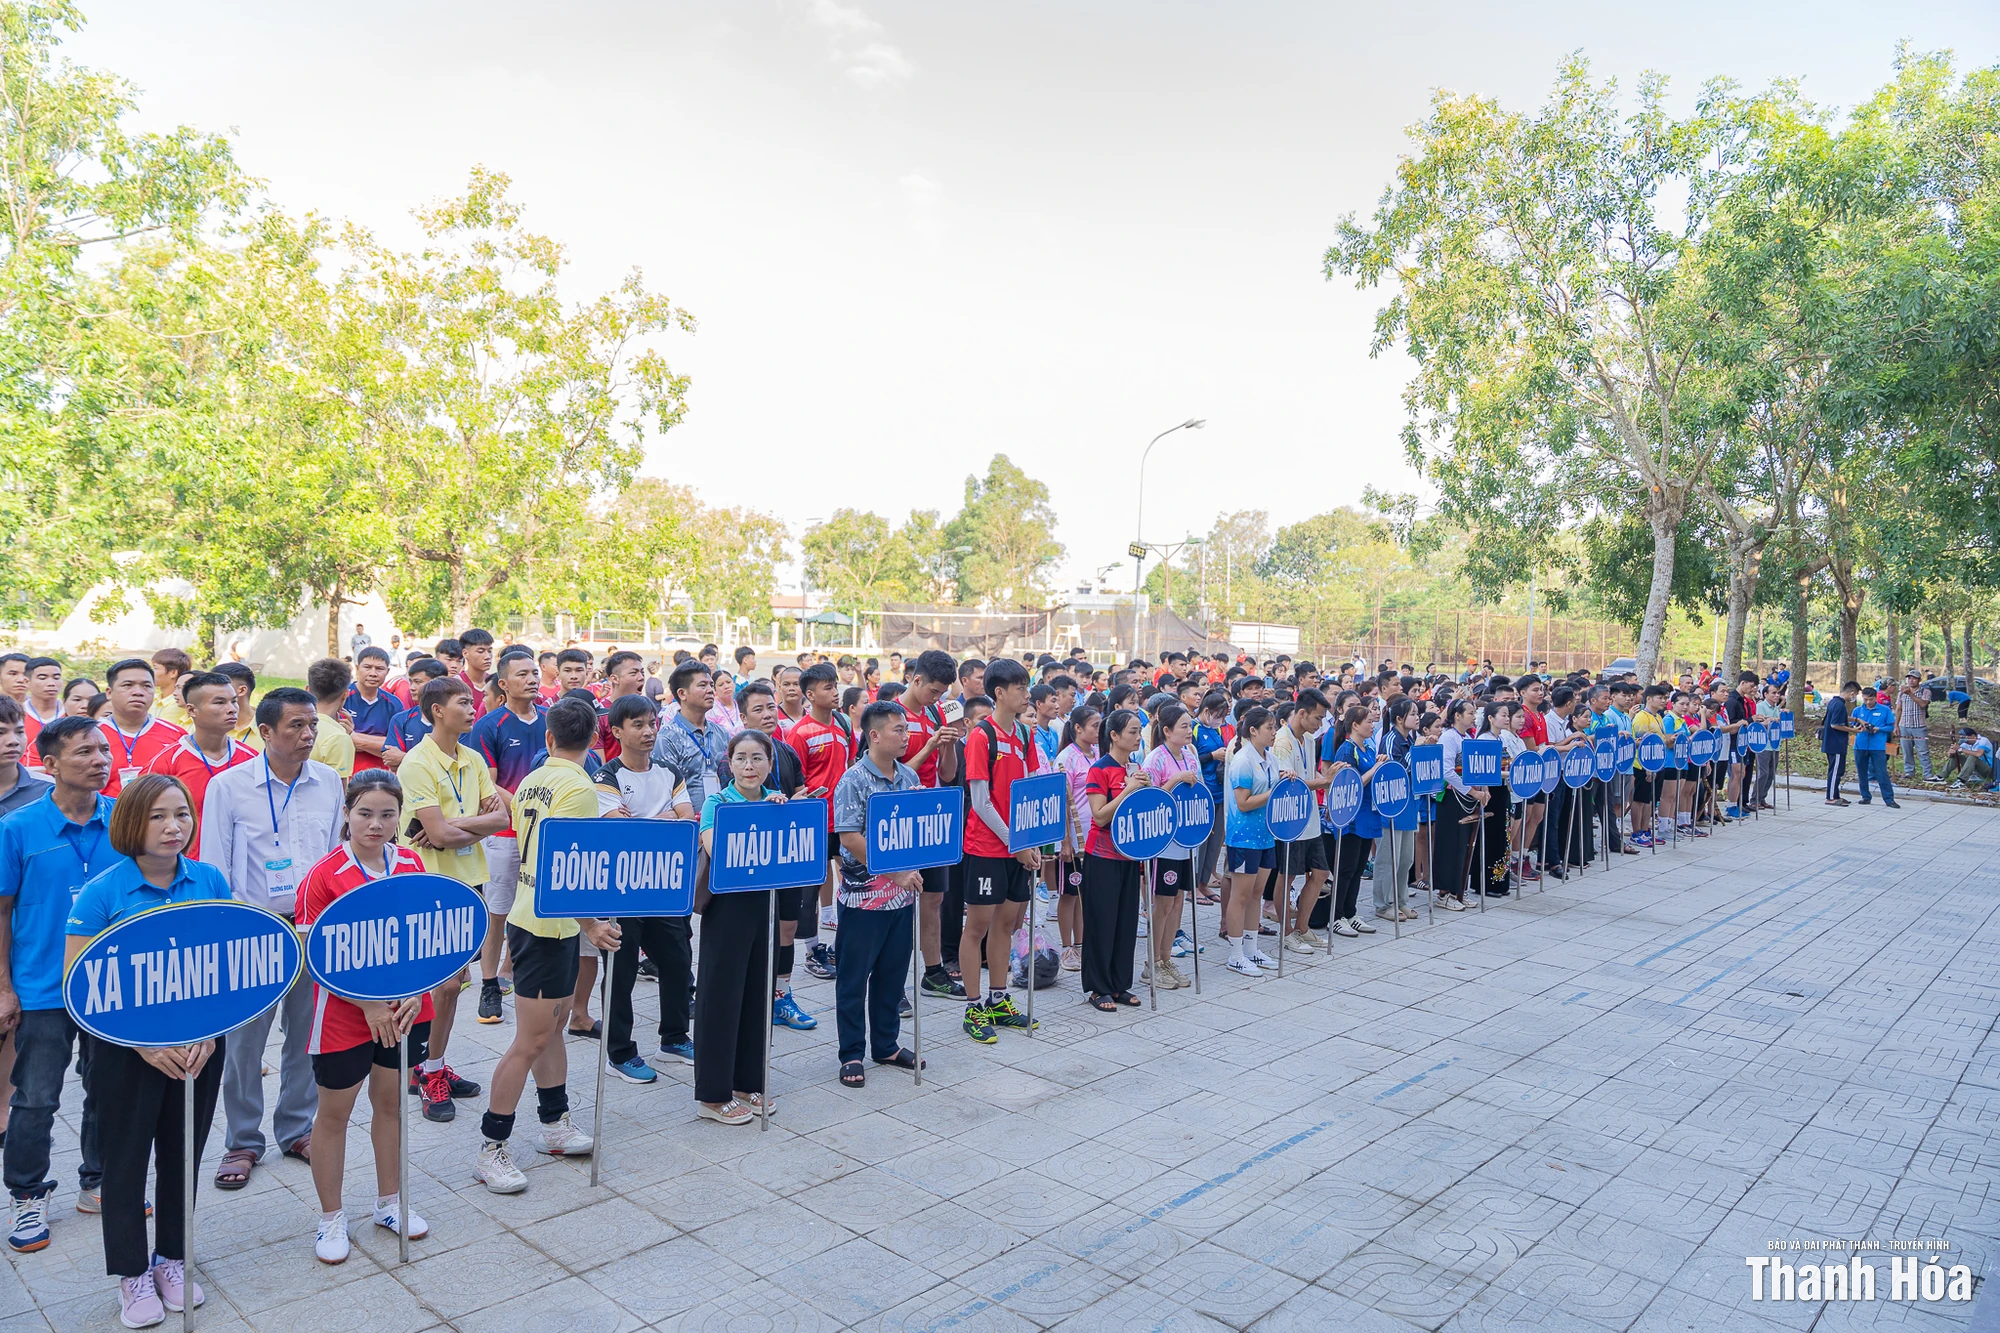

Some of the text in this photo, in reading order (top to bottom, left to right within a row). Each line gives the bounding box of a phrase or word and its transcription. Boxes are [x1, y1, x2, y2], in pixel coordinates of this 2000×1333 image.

[1468, 750, 1496, 774] VÂN DU
[1184, 794, 1210, 826] LUÔNG
[1272, 789, 1309, 824] MƯỜNG LÝ
[1389, 777, 1407, 804] QUANG
[878, 803, 952, 852] CẨM THỦY
[1015, 793, 1060, 832] ĐÔNG SƠN
[1118, 802, 1172, 844] BÁ THƯỚC
[521, 808, 537, 864] 7
[726, 821, 814, 874] MẬU LÂM
[551, 842, 684, 895] ĐÔNG QUANG
[978, 876, 992, 895] 14
[322, 900, 475, 974] TRUNG THÀNH
[84, 932, 284, 1016] XÃ THÀNH VINH
